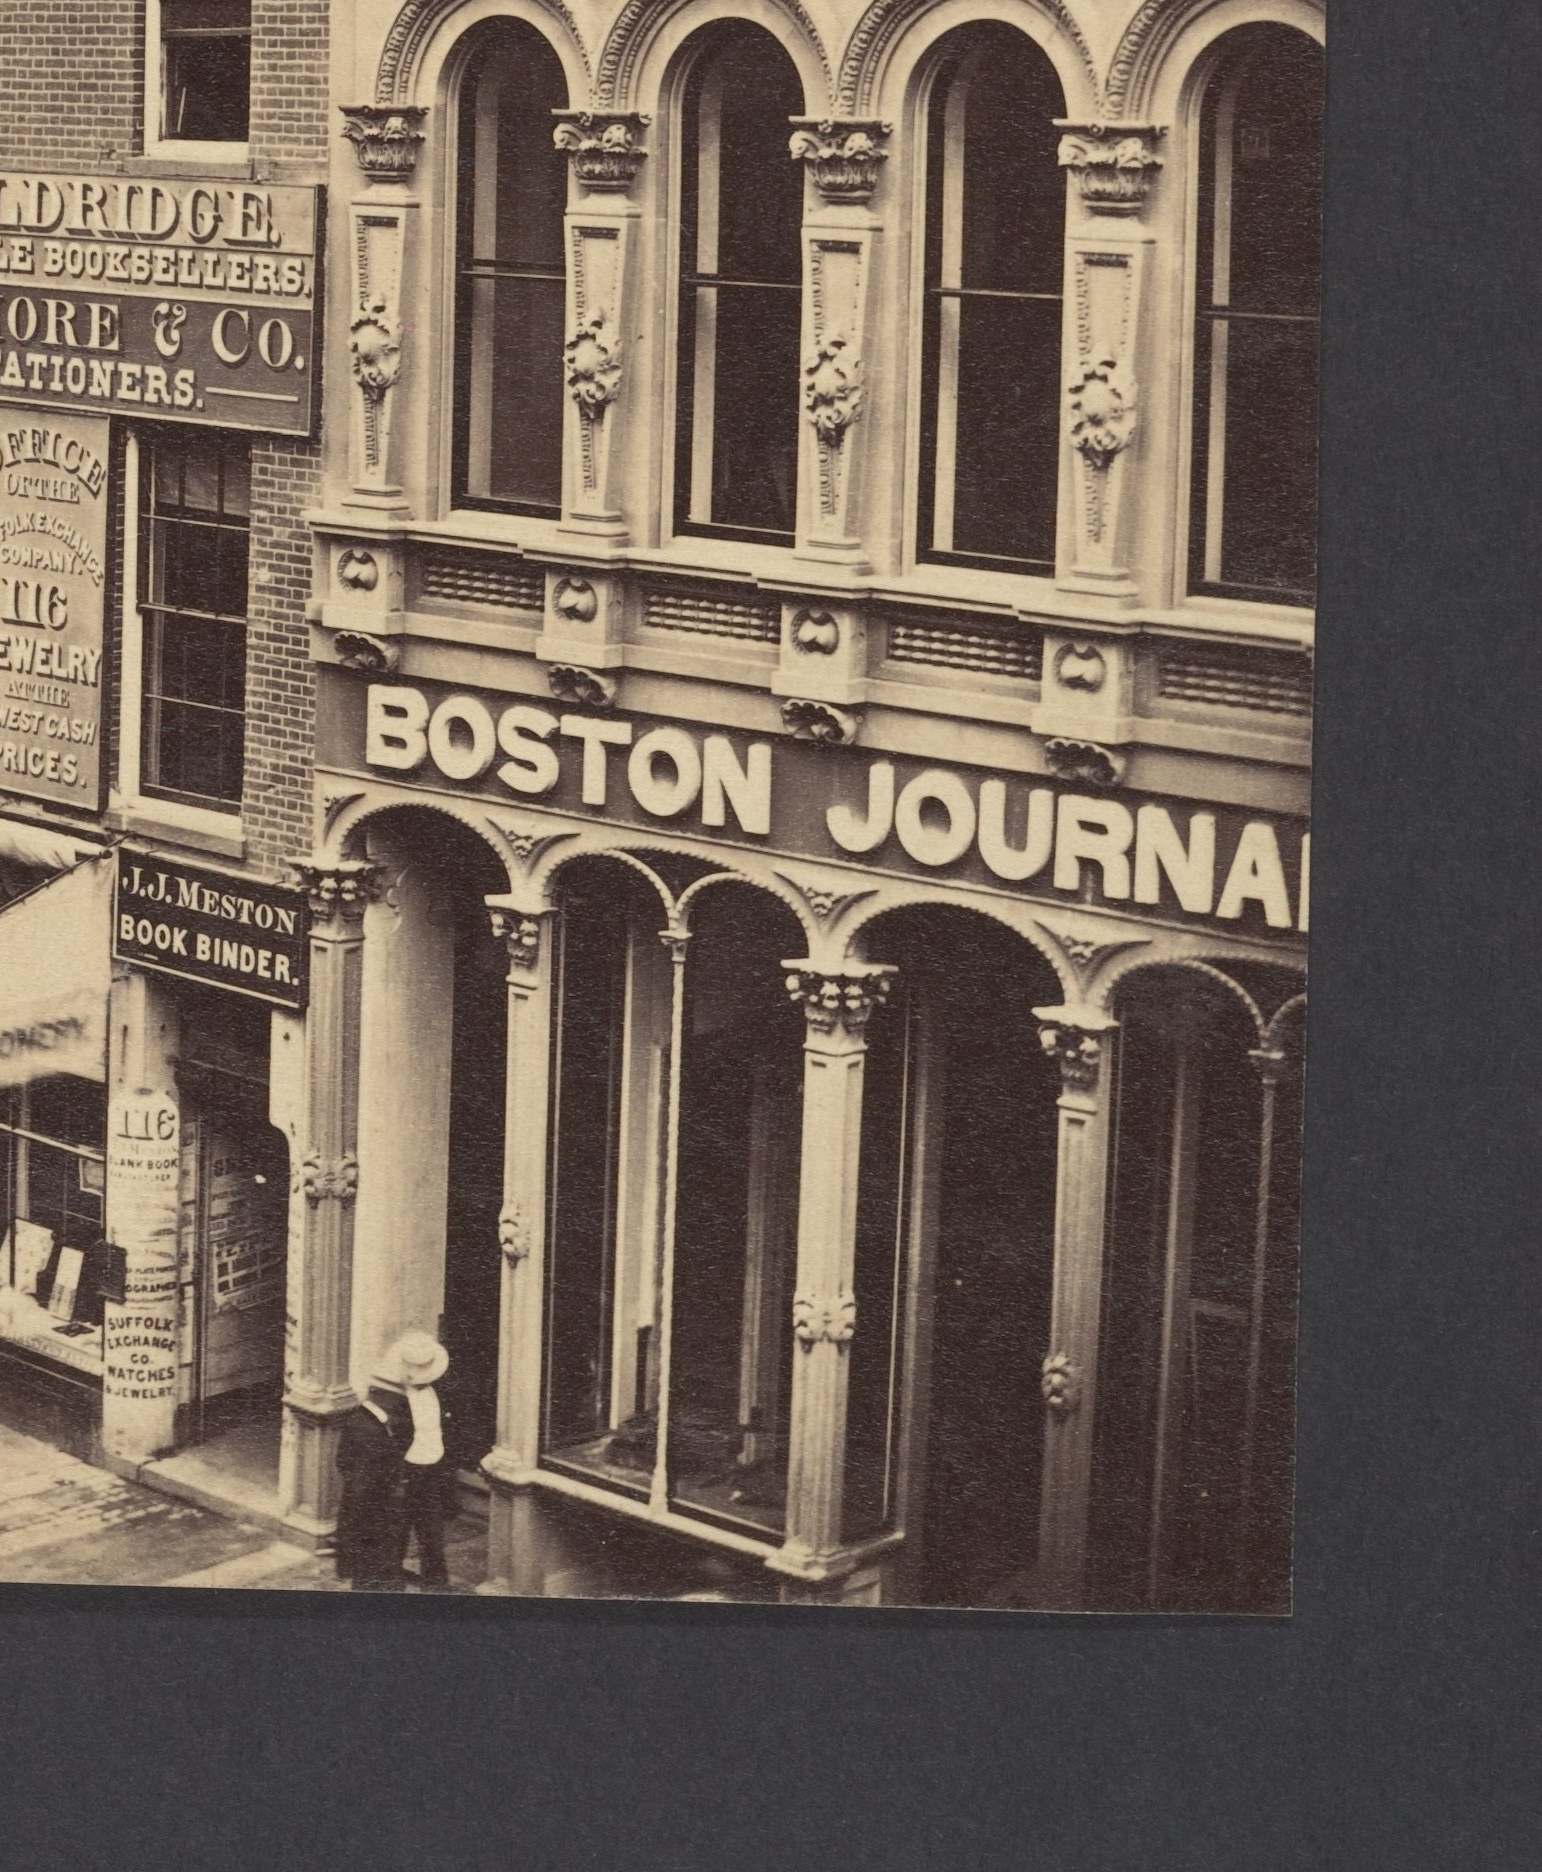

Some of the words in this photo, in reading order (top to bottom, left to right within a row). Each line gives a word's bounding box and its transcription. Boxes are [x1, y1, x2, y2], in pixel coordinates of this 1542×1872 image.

[43, 240, 312, 298] BOOKSELLERS.
[152, 302, 187, 358] &
[211, 308, 306, 371] CO.
[0, 544, 84, 577] COMPANY.
[37, 511, 106, 588] EXCHANGE
[0, 577, 69, 631] 116
[45, 713, 98, 746] CASH
[366, 683, 773, 836] BOSTON
[825, 761, 1311, 933] JOURNA
[120, 914, 189, 957] BOOK
[196, 933, 300, 987] BINDER.
[116, 1108, 176, 1141] 116
[147, 1157, 179, 1169] BOOK
[108, 1316, 174, 1333] SUFFOLK
[107, 1334, 177, 1353] EXCHANGE
[107, 1365, 176, 1383] WATCHES
